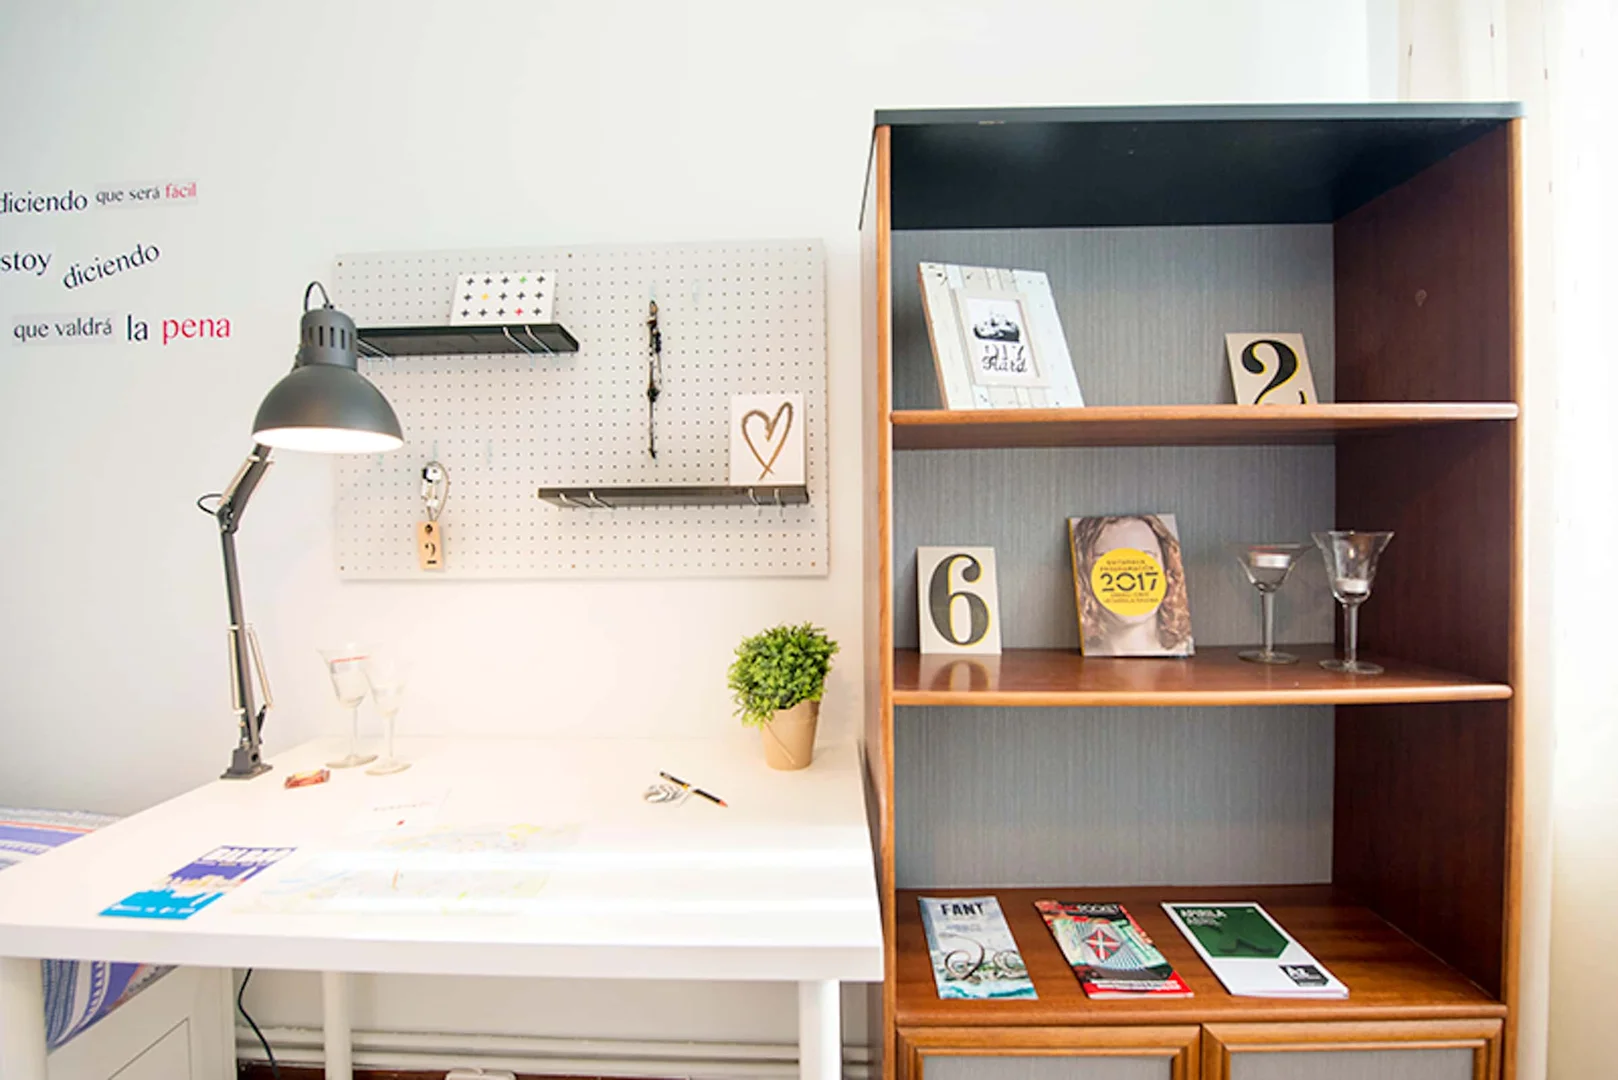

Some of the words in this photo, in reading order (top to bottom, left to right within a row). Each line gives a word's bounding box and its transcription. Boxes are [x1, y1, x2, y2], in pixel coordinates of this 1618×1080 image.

[0, 189, 88, 213] diciendo
[95, 190, 124, 206] que
[129, 186, 160, 200] será
[165, 182, 197, 199] fácil
[0, 250, 53, 277] stoy
[63, 243, 160, 289] diciendo
[13, 322, 49, 342] que
[55, 317, 112, 337] valdrá
[127, 314, 149, 341] la
[162, 317, 231, 346] pena
[1241, 339, 1308, 404] 2
[424, 541, 437, 565] 2
[1100, 571, 1159, 592] 2017
[928, 553, 991, 646] 6
[940, 902, 985, 916] FANT
